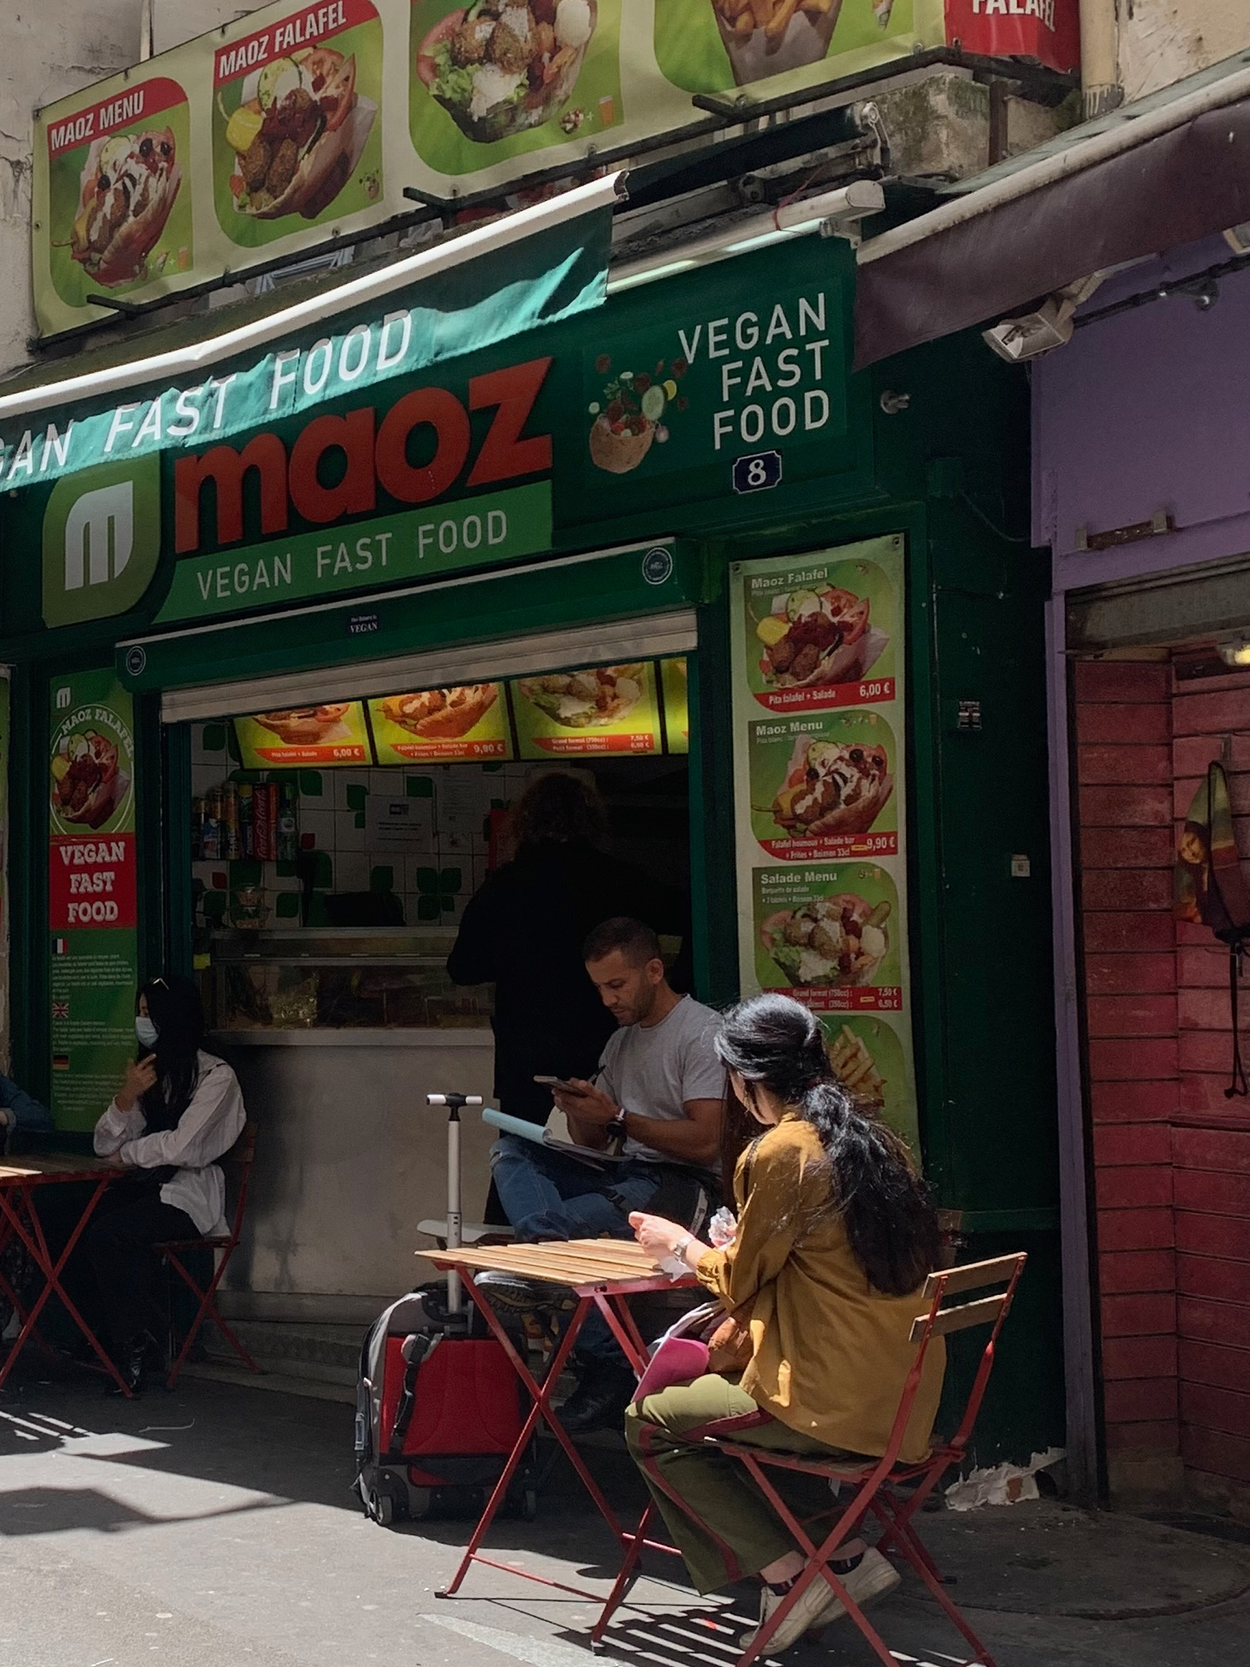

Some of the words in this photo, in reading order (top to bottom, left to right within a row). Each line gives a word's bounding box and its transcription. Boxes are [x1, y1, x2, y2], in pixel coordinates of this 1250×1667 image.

[218, 34, 269, 79] MAOZ
[273, 0, 347, 53] FALAFEL
[50, 111, 95, 151] MAOZ
[98, 90, 145, 131] MENU
[677, 292, 827, 365] VEGAN
[103, 374, 238, 453] FAST
[268, 308, 413, 409] FOOD
[721, 339, 830, 402] FAST
[713, 389, 830, 450] FOOD
[174, 356, 554, 554] maoz
[746, 458, 768, 487] 8
[196, 554, 293, 601] VEGAN
[316, 532, 393, 580] FAST
[417, 509, 509, 559] FOOD
[751, 577, 784, 590] Maoz
[787, 567, 829, 585] Falafel
[350, 622, 378, 633] VEGAN
[768, 694, 783, 706] Pita
[812, 689, 837, 701] Salade
[859, 683, 882, 699] 6,00
[883, 682, 891, 694] €
[61, 708, 93, 735] MAOZ
[755, 725, 788, 736] Maoz
[789, 721, 824, 733] Menu
[333, 748, 352, 759] 6,00
[353, 748, 360, 757] €
[496, 743, 504, 753] €
[59, 841, 126, 867] VEGAN
[790, 850, 807, 859] Frites
[866, 837, 888, 851] 9,90
[889, 836, 896, 848] €
[69, 872, 116, 895] FAST
[761, 873, 801, 885] Salade
[804, 871, 838, 883] Menu
[67, 900, 119, 924] FOOD
